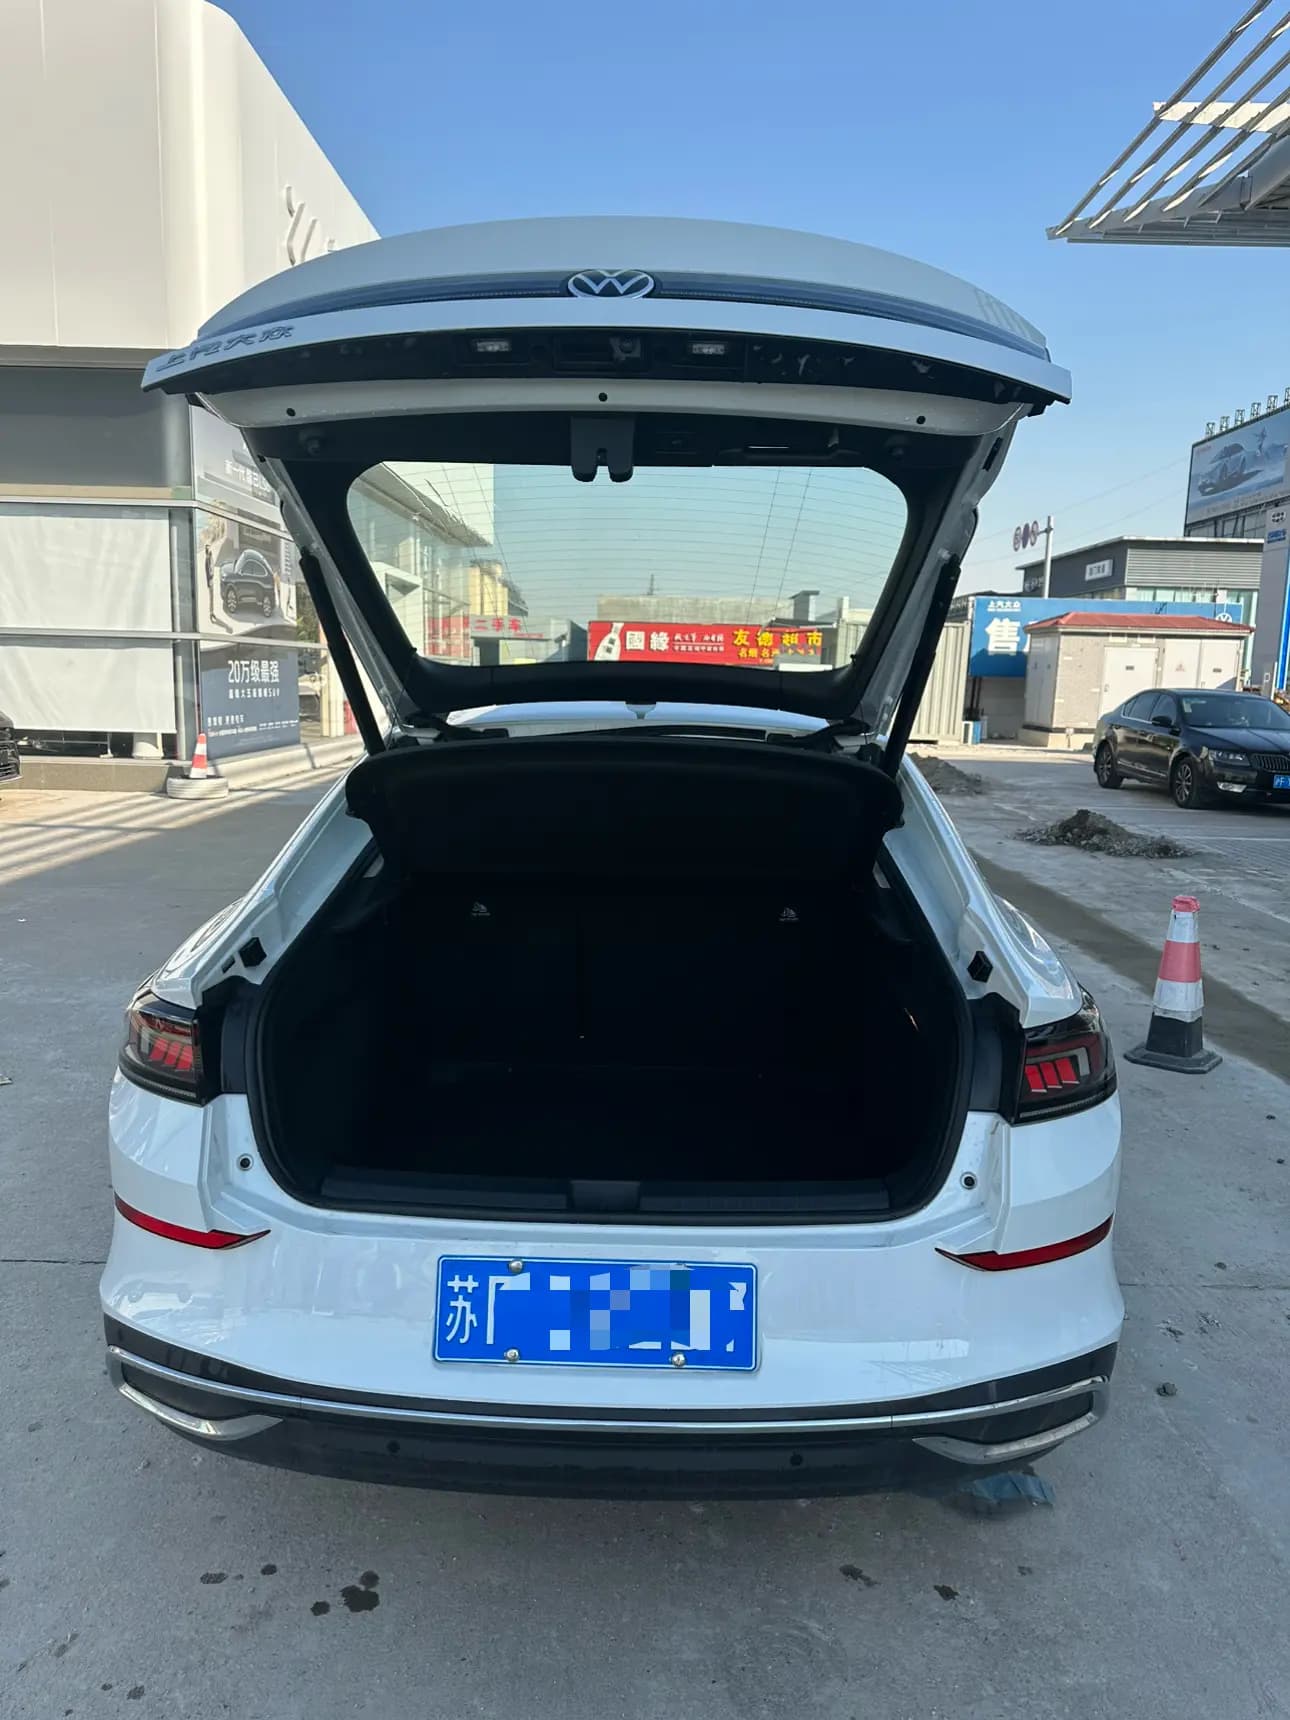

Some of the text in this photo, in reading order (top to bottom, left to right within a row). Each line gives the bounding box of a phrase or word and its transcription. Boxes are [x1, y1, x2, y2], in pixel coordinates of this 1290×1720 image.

[474, 617, 522, 632] 二手车
[228, 660, 280, 683] 20万级最强
